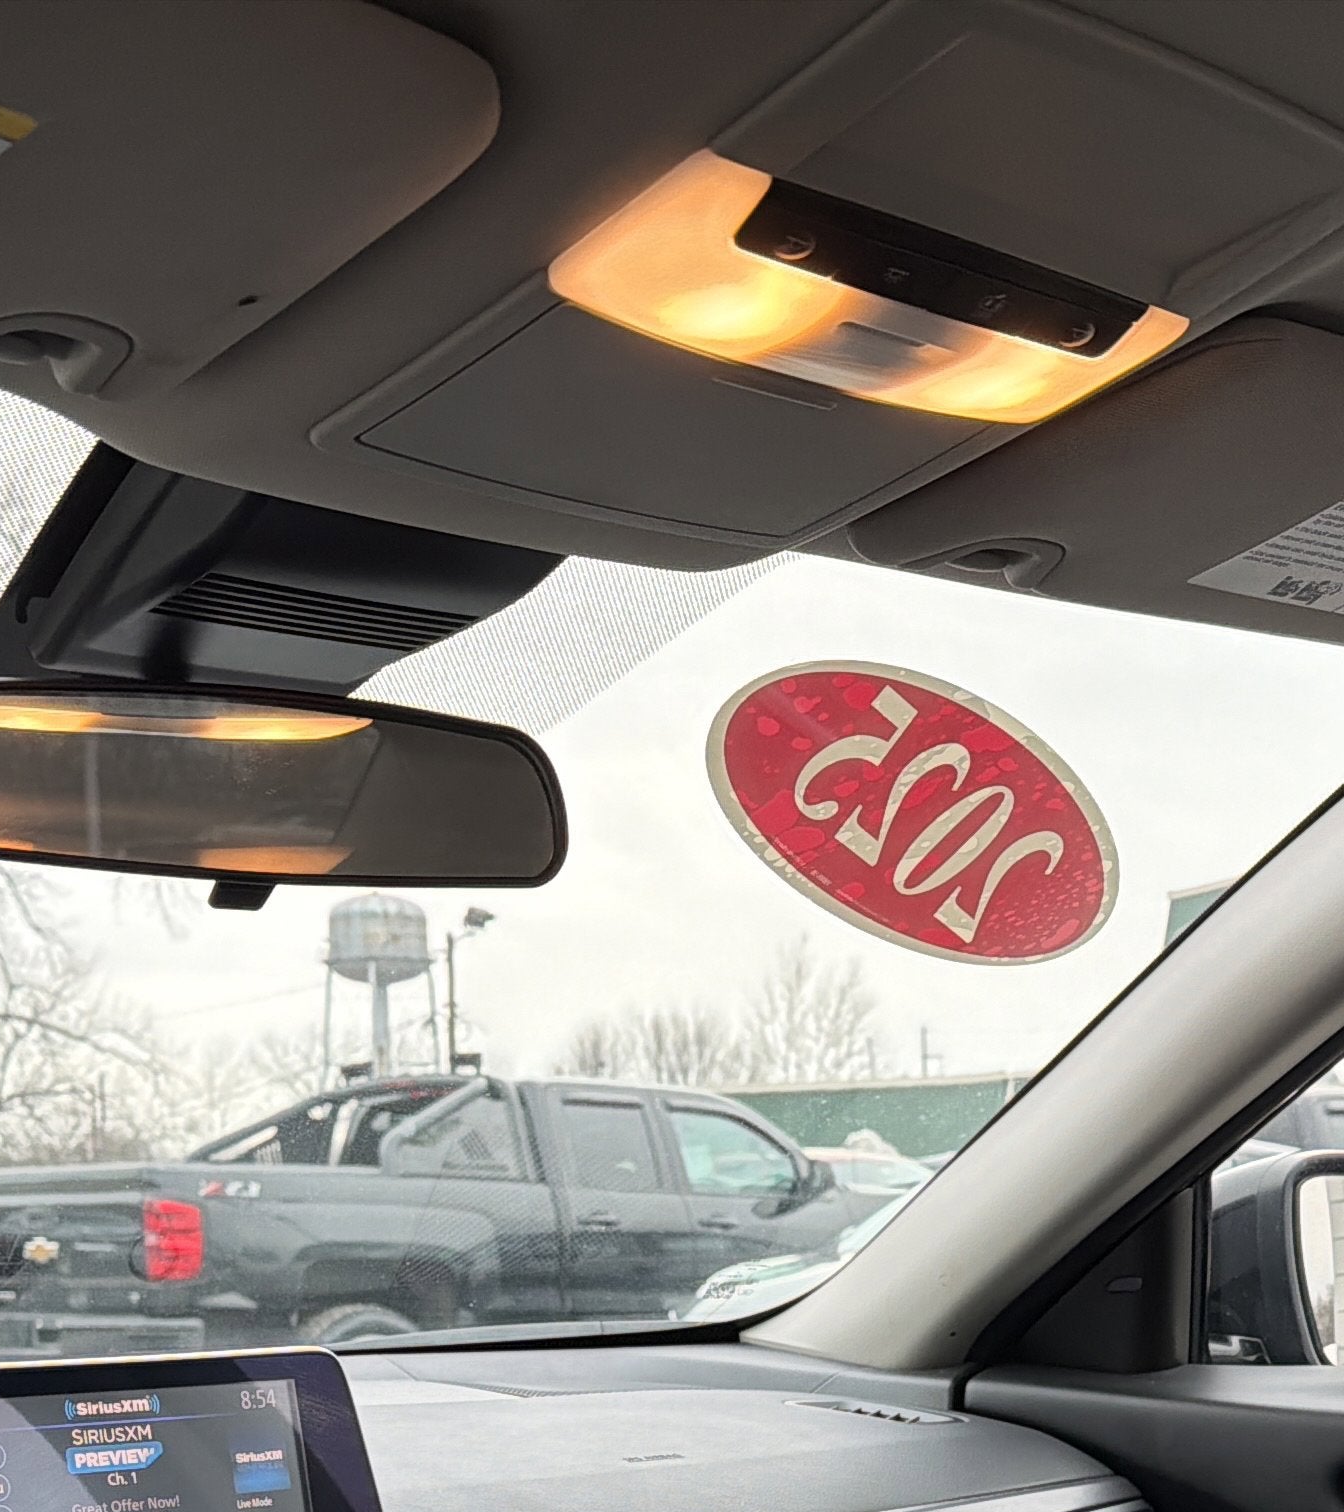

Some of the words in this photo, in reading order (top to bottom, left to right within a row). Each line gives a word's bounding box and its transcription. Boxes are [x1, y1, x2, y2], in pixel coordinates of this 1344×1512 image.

[240, 1389, 277, 1409] 8:54
[71, 1424, 153, 1446] SIRIUSXM
[74, 1447, 155, 1469] PREVIEW
[107, 1473, 129, 1486] Ch.
[131, 1471, 138, 1485] 1
[110, 1497, 144, 1512] Offer
[145, 1494, 181, 1509] Now!
[237, 1499, 253, 1510] Live
[252, 1497, 273, 1509] Mode
